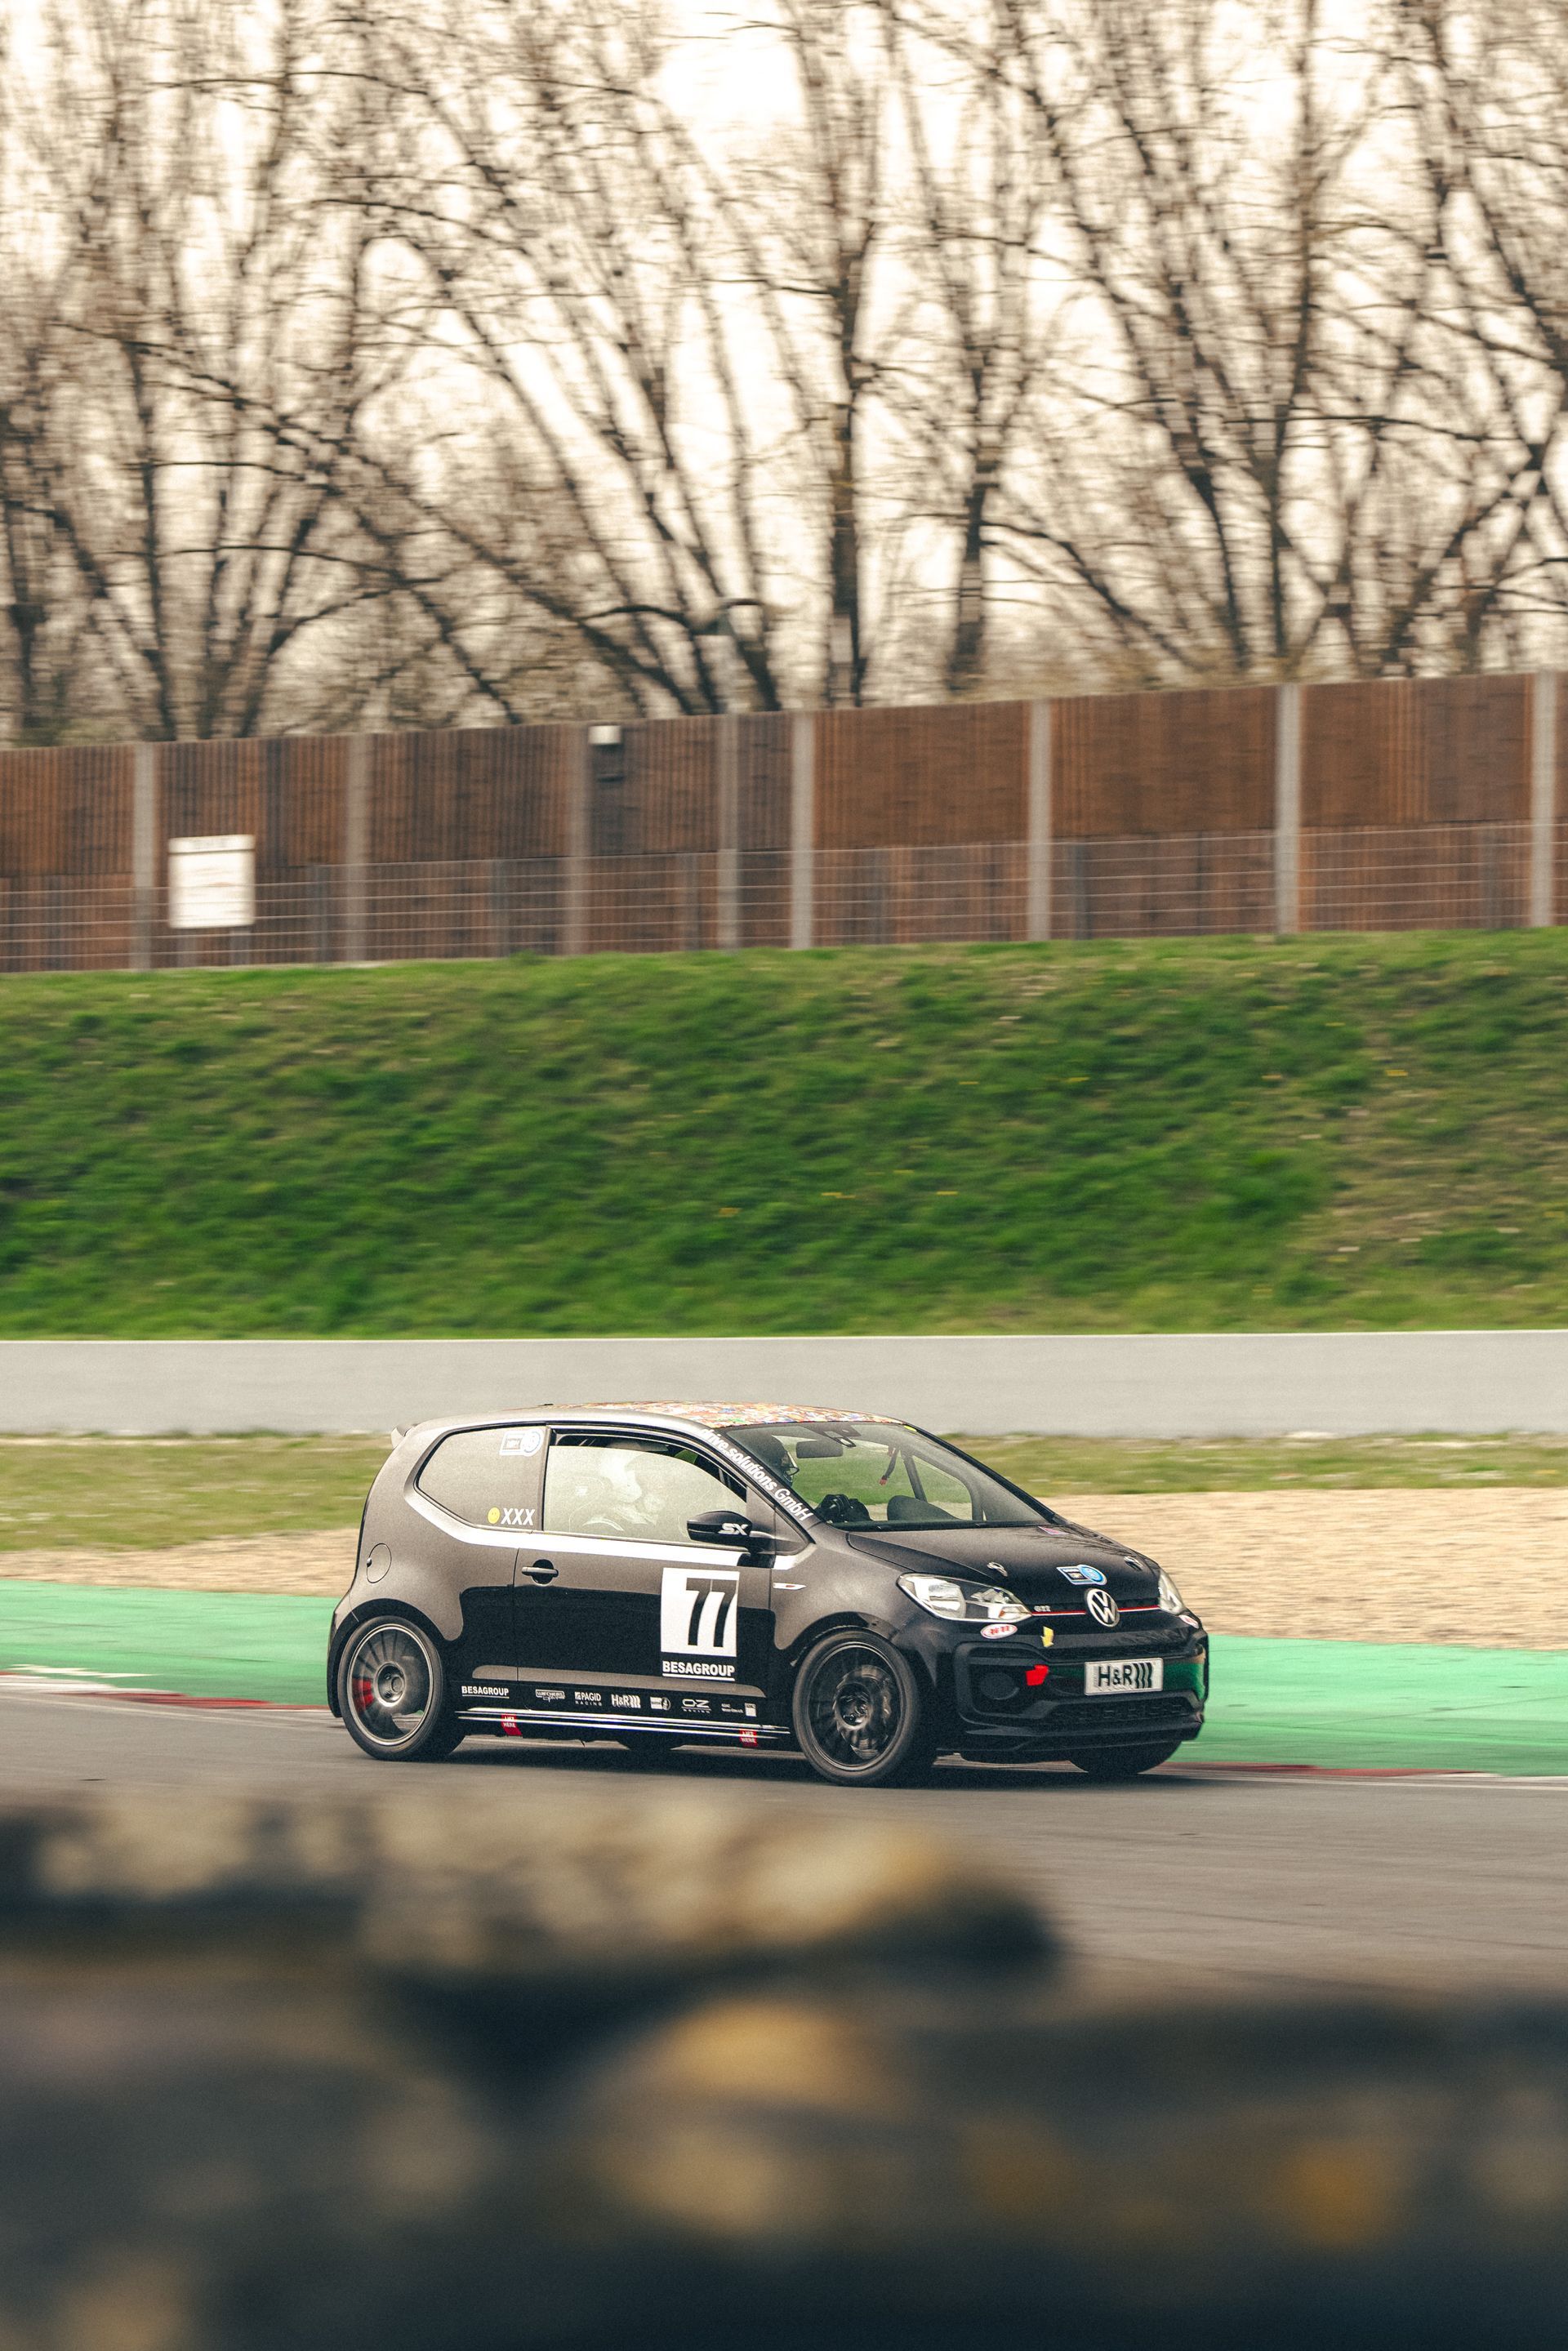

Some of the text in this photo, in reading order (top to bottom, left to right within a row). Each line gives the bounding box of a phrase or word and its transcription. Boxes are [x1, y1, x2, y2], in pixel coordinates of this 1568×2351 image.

[775, 1489, 813, 1521] GmbH
[501, 1508, 535, 1525] XXX
[719, 1523, 749, 1535] SX
[686, 1578, 737, 1648] 77
[662, 1661, 735, 1676] BESAGROUP
[461, 1686, 510, 1696] BESAGROUP
[581, 1692, 602, 1702] PAGID
